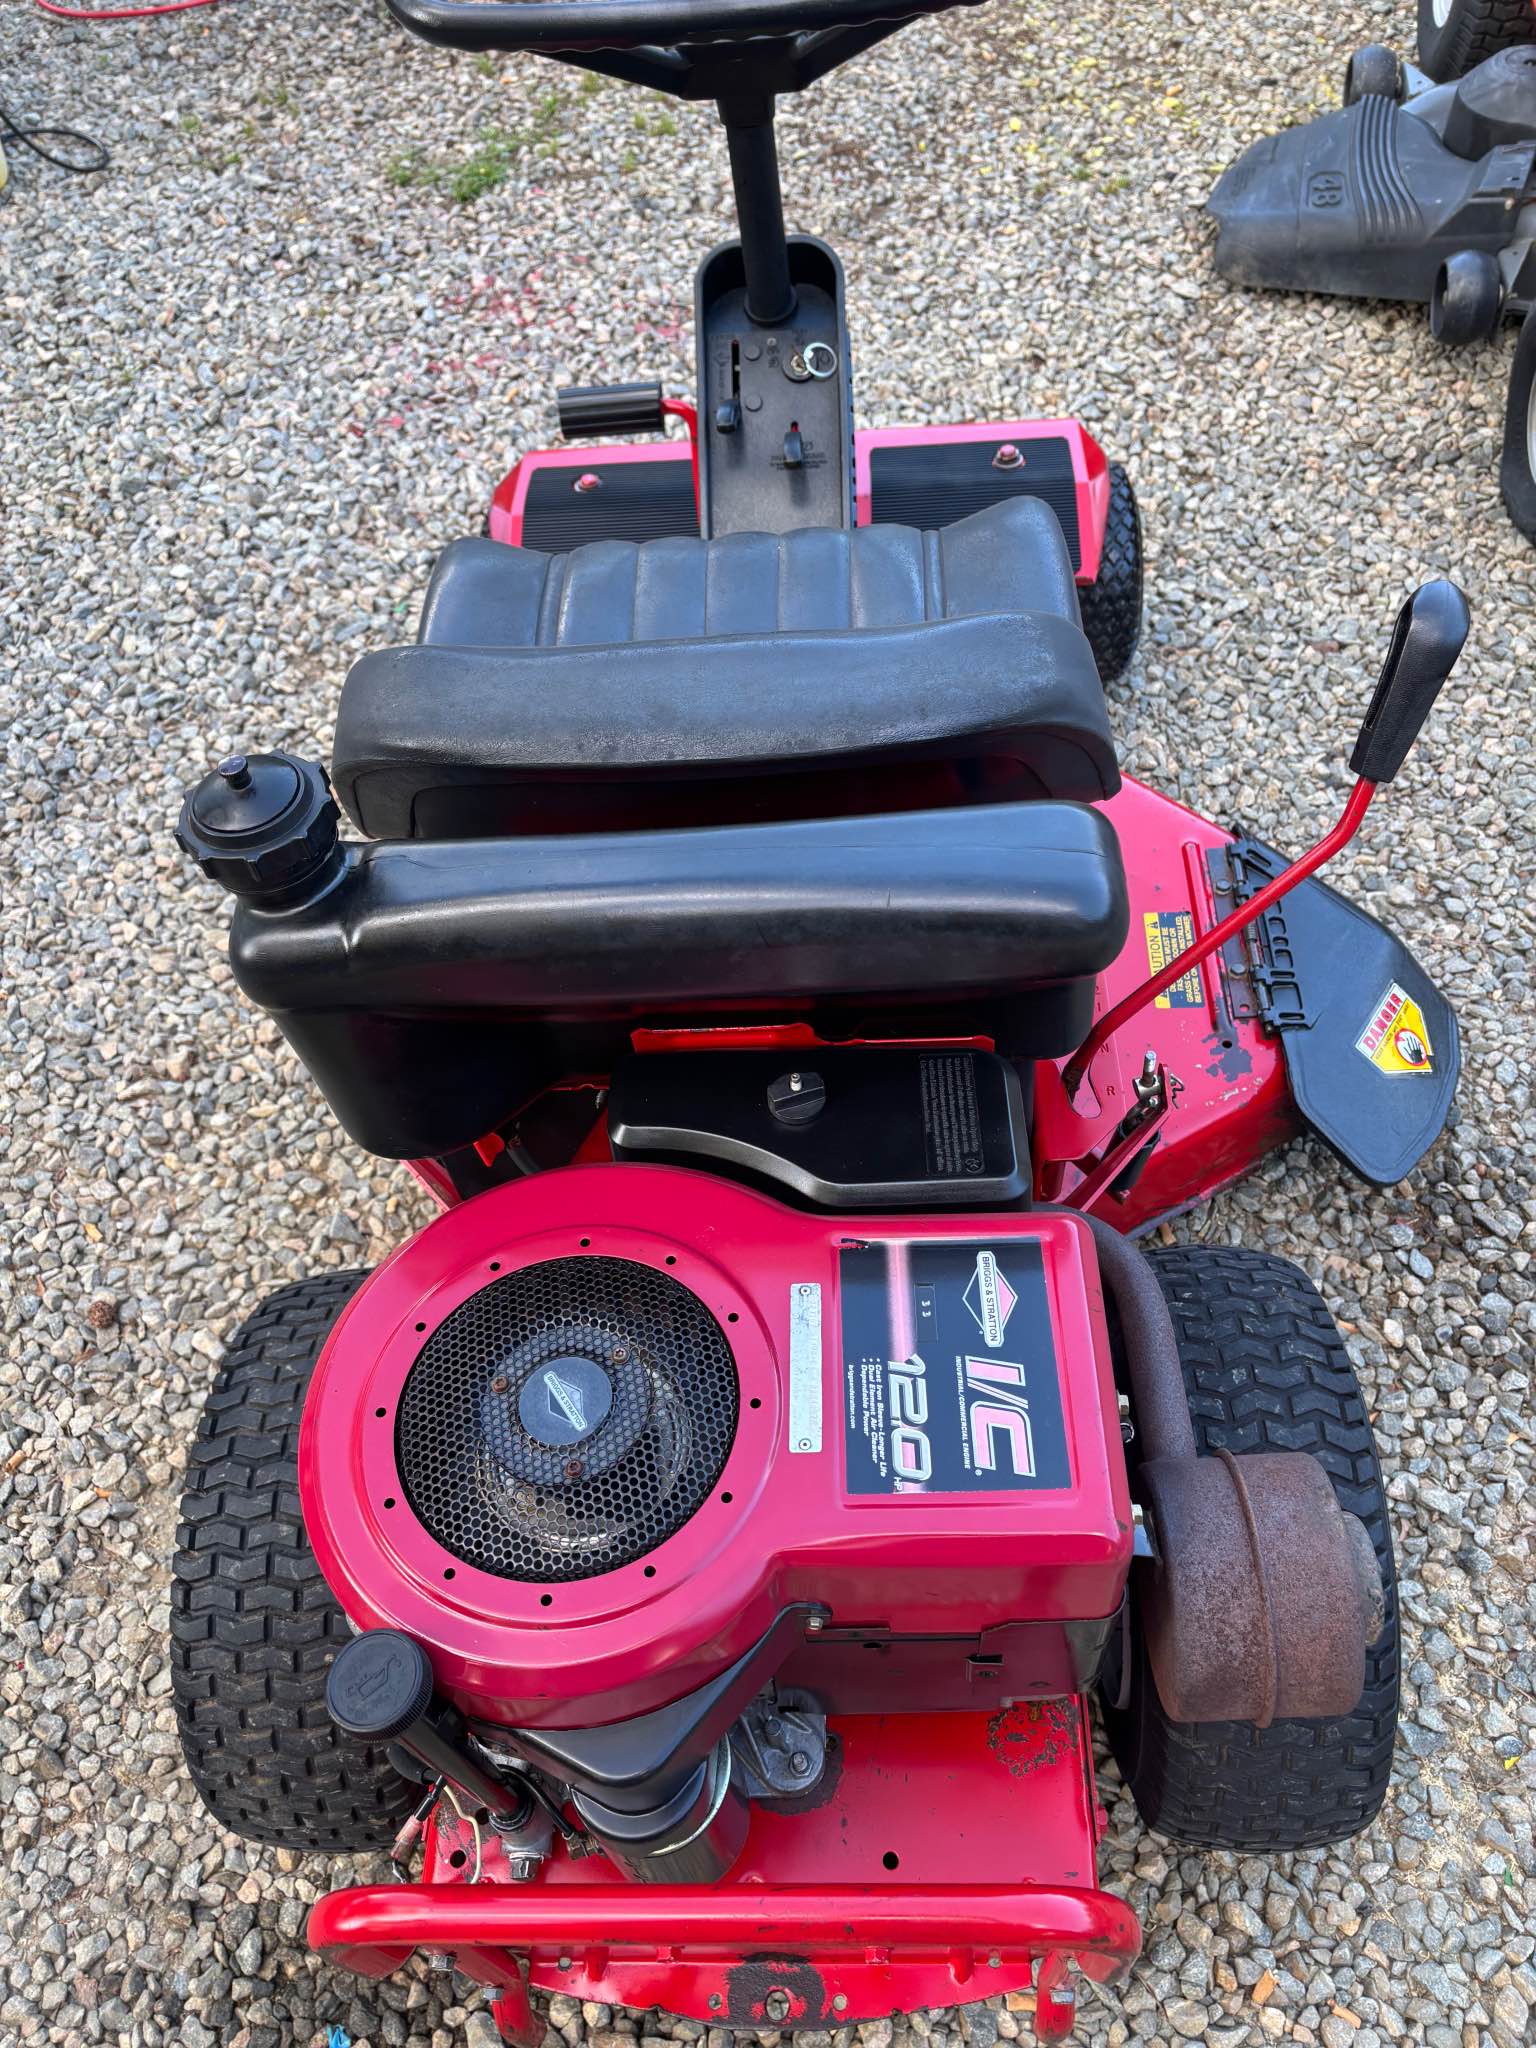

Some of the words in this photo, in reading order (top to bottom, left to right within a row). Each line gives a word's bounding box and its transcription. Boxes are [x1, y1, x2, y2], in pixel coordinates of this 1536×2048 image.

[1149, 935, 1163, 973] UTION
[1363, 993, 1402, 1050] DANGER
[1106, 1085, 1116, 1096] R
[982, 1256, 996, 1289] BRIGGS
[986, 1297, 998, 1342] STRATTON
[547, 1376, 563, 1396] BRIGGS
[563, 1401, 584, 1428] STRATTON
[860, 1364, 869, 1409] Dependable
[862, 1411, 870, 1436] Power
[888, 1353, 932, 1481] 12.0
[955, 1356, 968, 1440] INDUSTRIAL/COMMERCIAL
[962, 1443, 971, 1469] ENGINE
[965, 1355, 1036, 1478] I/C
[879, 1462, 887, 1478] Life
[893, 1477, 902, 1491] HP
